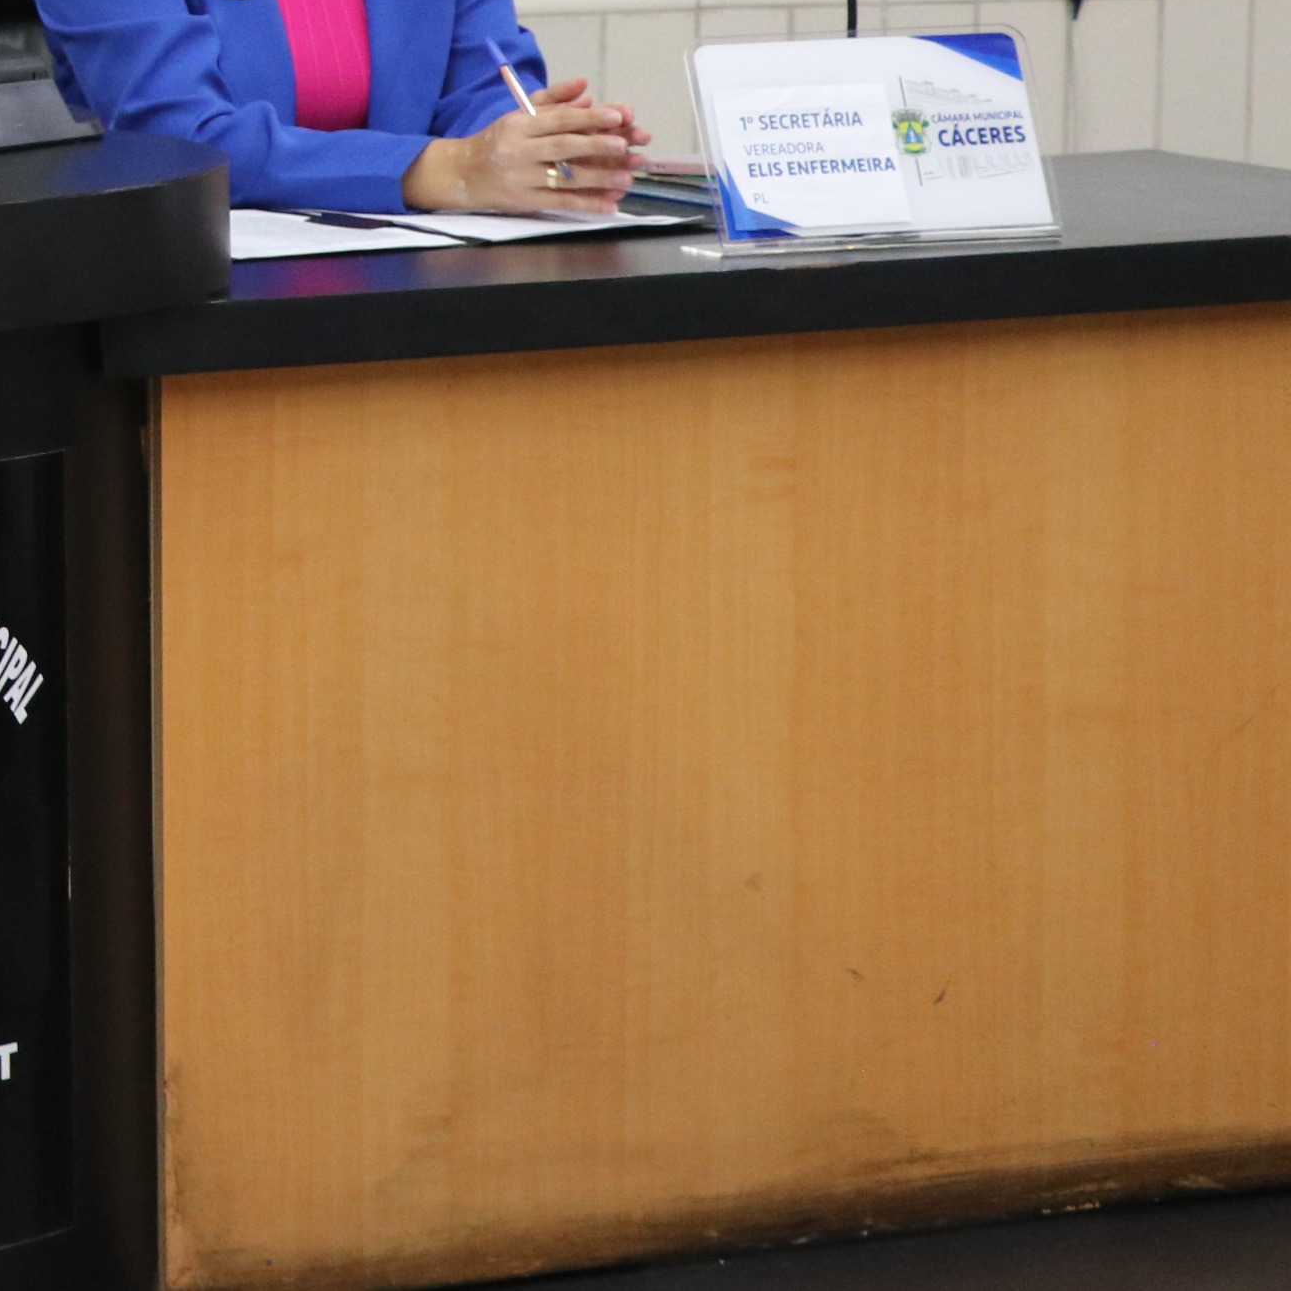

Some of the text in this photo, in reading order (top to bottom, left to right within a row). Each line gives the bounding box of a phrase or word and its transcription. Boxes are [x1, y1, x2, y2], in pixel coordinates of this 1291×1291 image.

[758, 108, 863, 131] SECRETÁRIA
[931, 110, 1024, 124] CÂMARA MUNICIPAL
[938, 123, 1026, 147] CÁCERES
[744, 142, 825, 157] VEREADORA
[748, 157, 896, 178] ELIS ENFERMEIRA
[753, 192, 769, 204] PL
